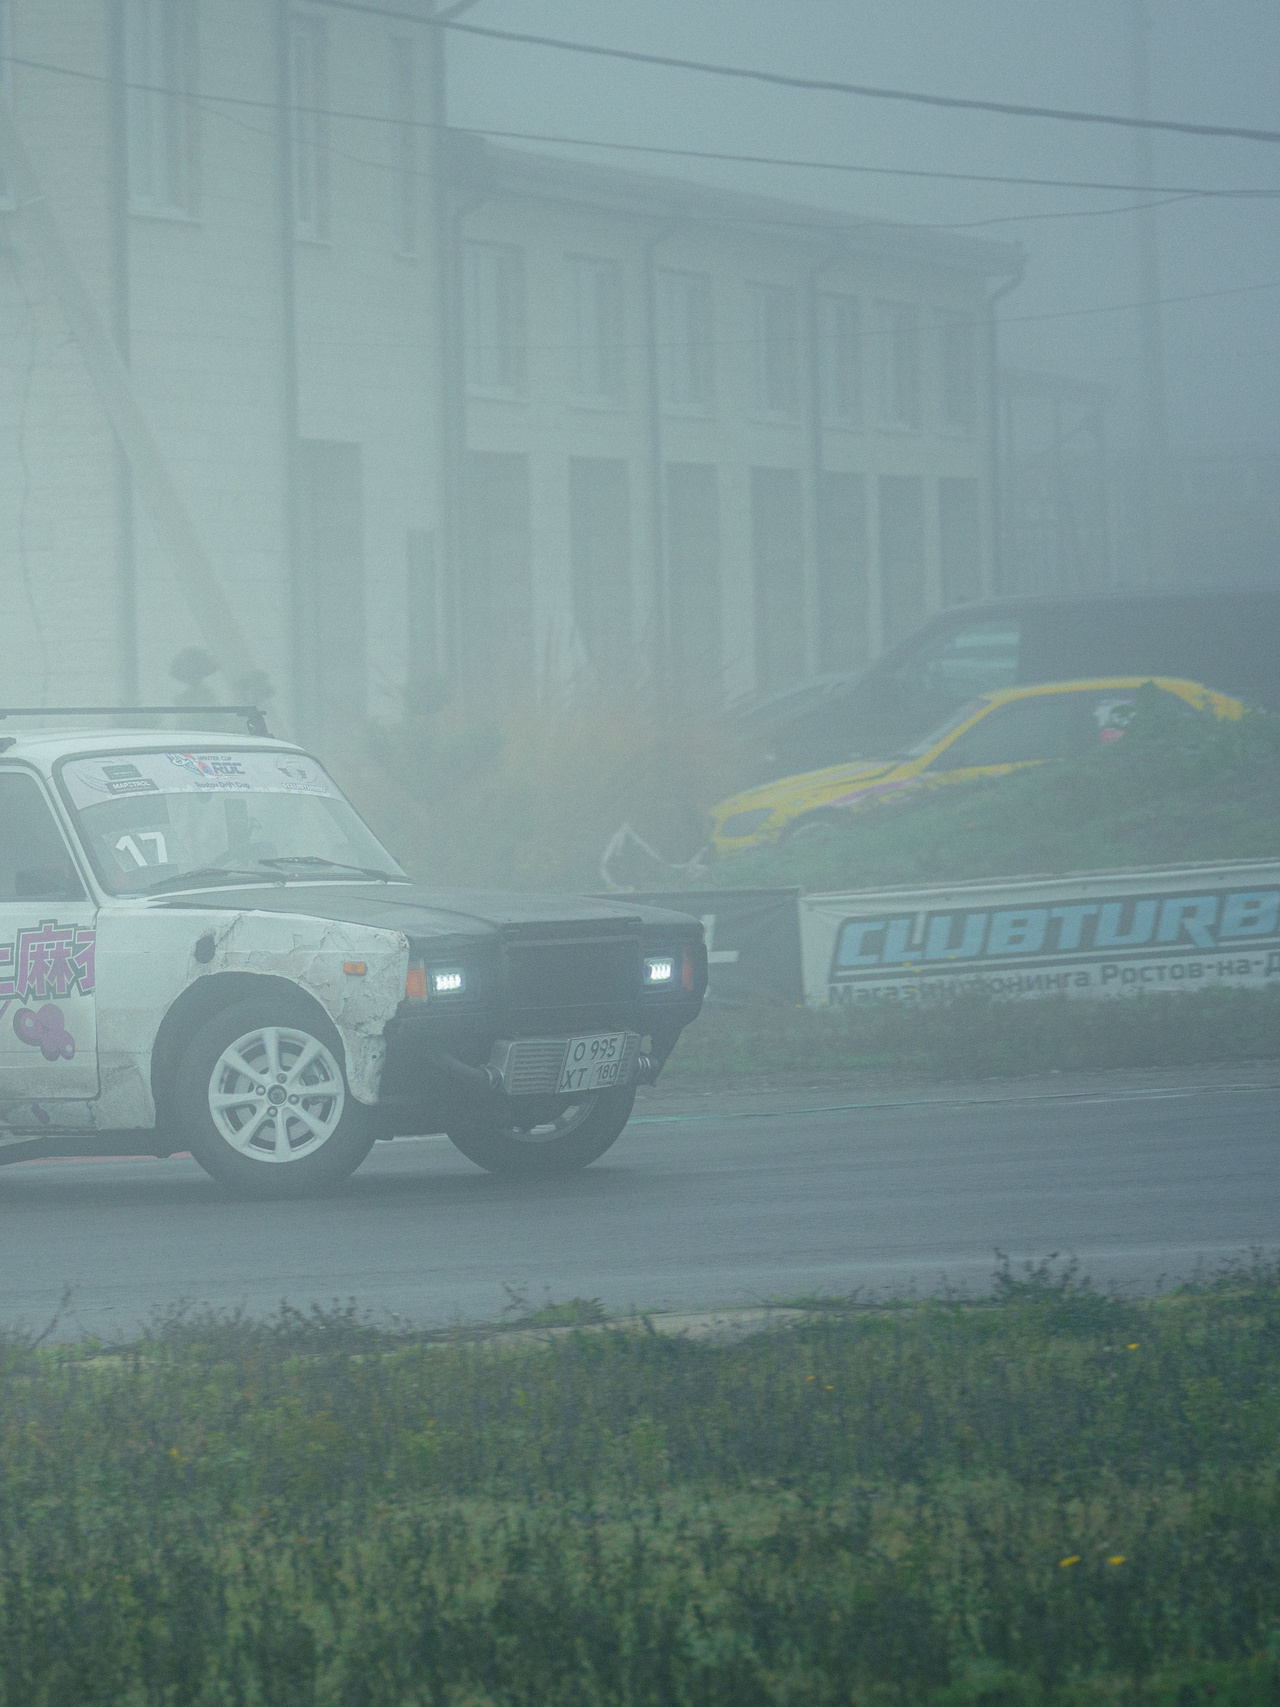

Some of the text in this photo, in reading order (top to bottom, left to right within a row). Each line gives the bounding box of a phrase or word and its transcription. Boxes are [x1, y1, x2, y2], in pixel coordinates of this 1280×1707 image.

[115, 831, 168, 867] 17
[590, 1037, 618, 1060] 995
[560, 1067, 588, 1089] ХТ
[596, 1063, 618, 1080] 180
